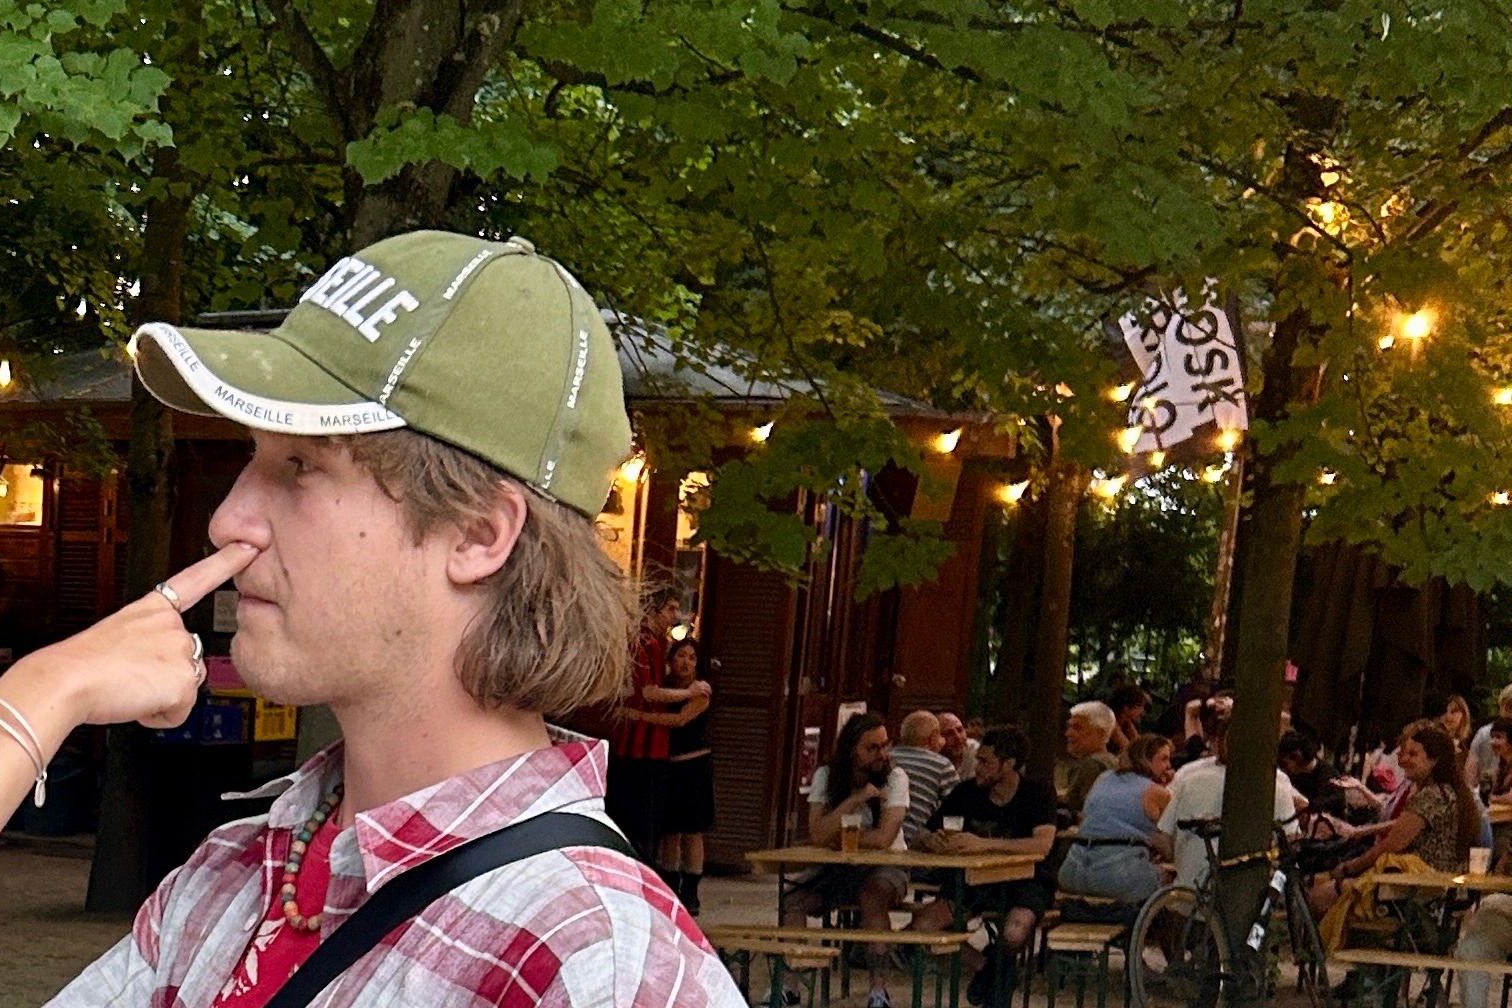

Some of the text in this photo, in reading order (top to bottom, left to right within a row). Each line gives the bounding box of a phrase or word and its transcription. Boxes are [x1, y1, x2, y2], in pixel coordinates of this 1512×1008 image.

[299, 256, 420, 343] EILLE
[214, 385, 294, 426] MARSEILLE
[379, 336, 422, 407] ARSEILLE
[566, 329, 589, 410] MARSEILLE
